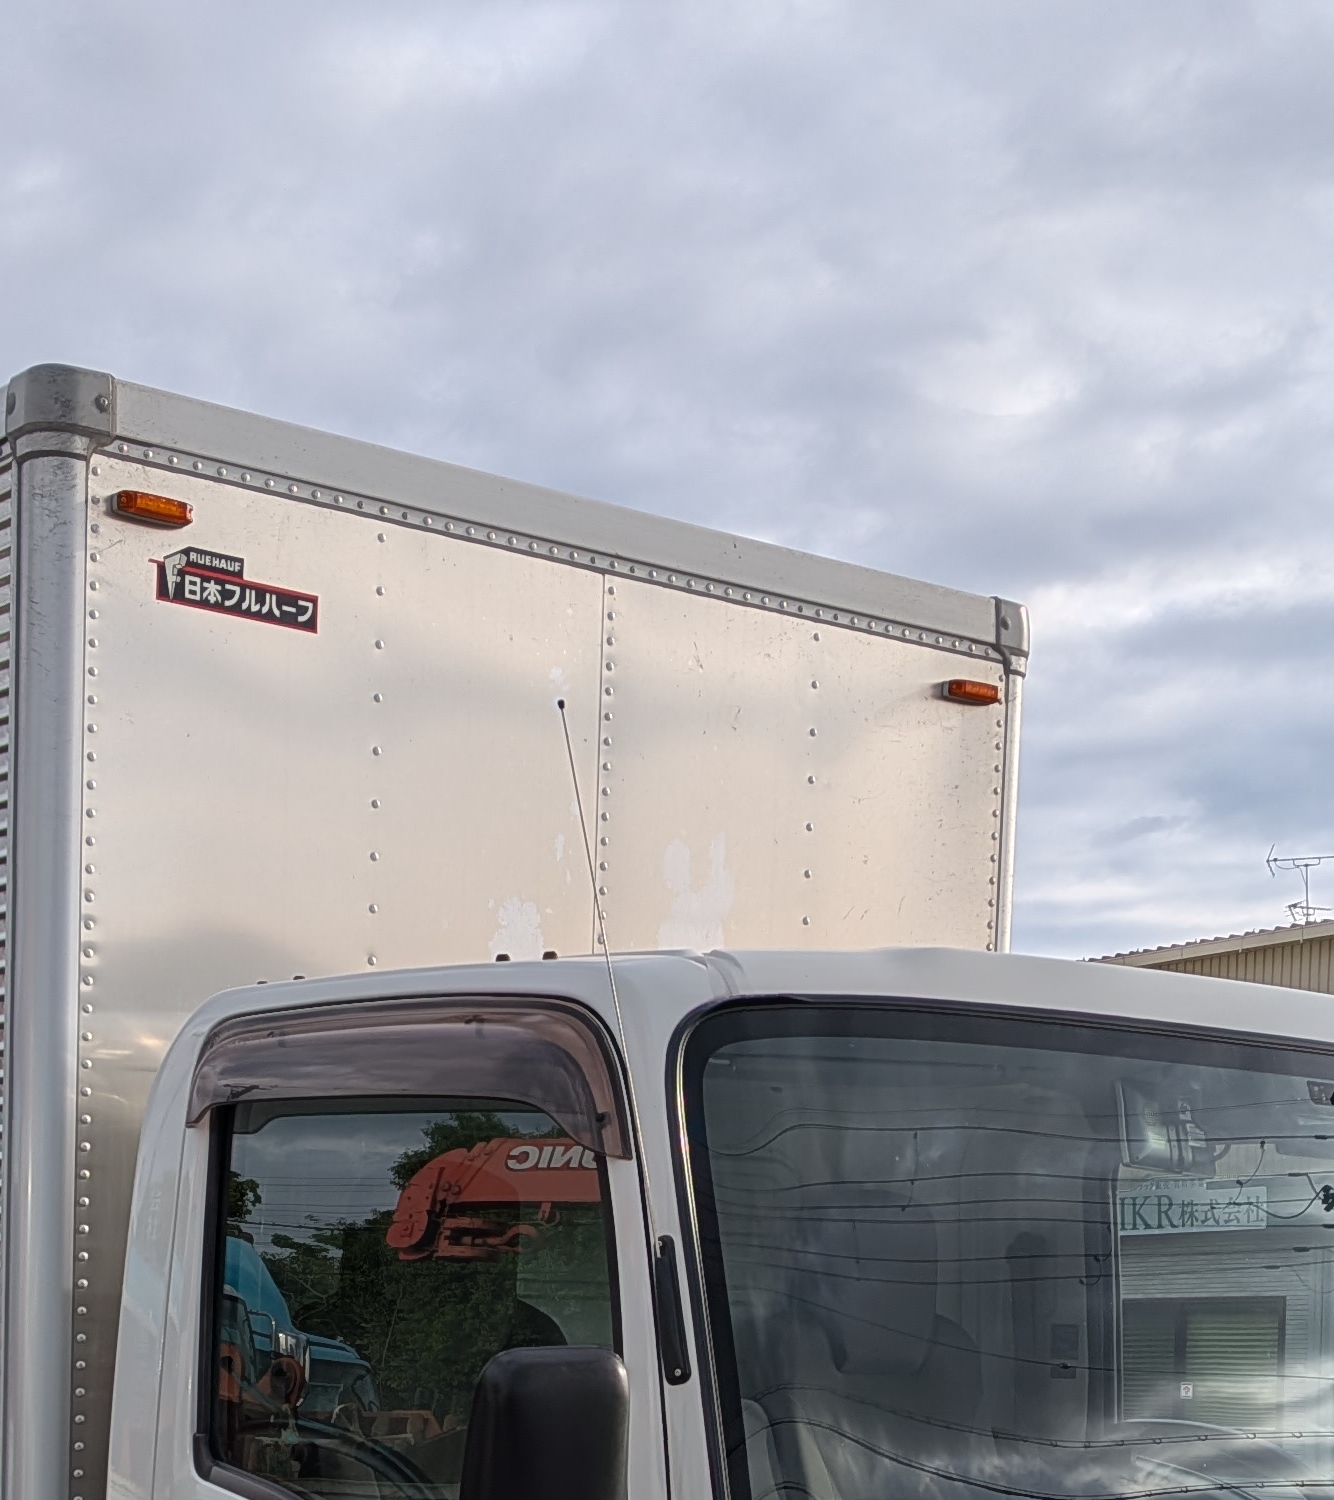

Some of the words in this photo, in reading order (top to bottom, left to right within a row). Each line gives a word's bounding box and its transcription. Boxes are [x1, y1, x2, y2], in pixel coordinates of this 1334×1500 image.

[184, 574, 314, 623] 日本フルハーフ
